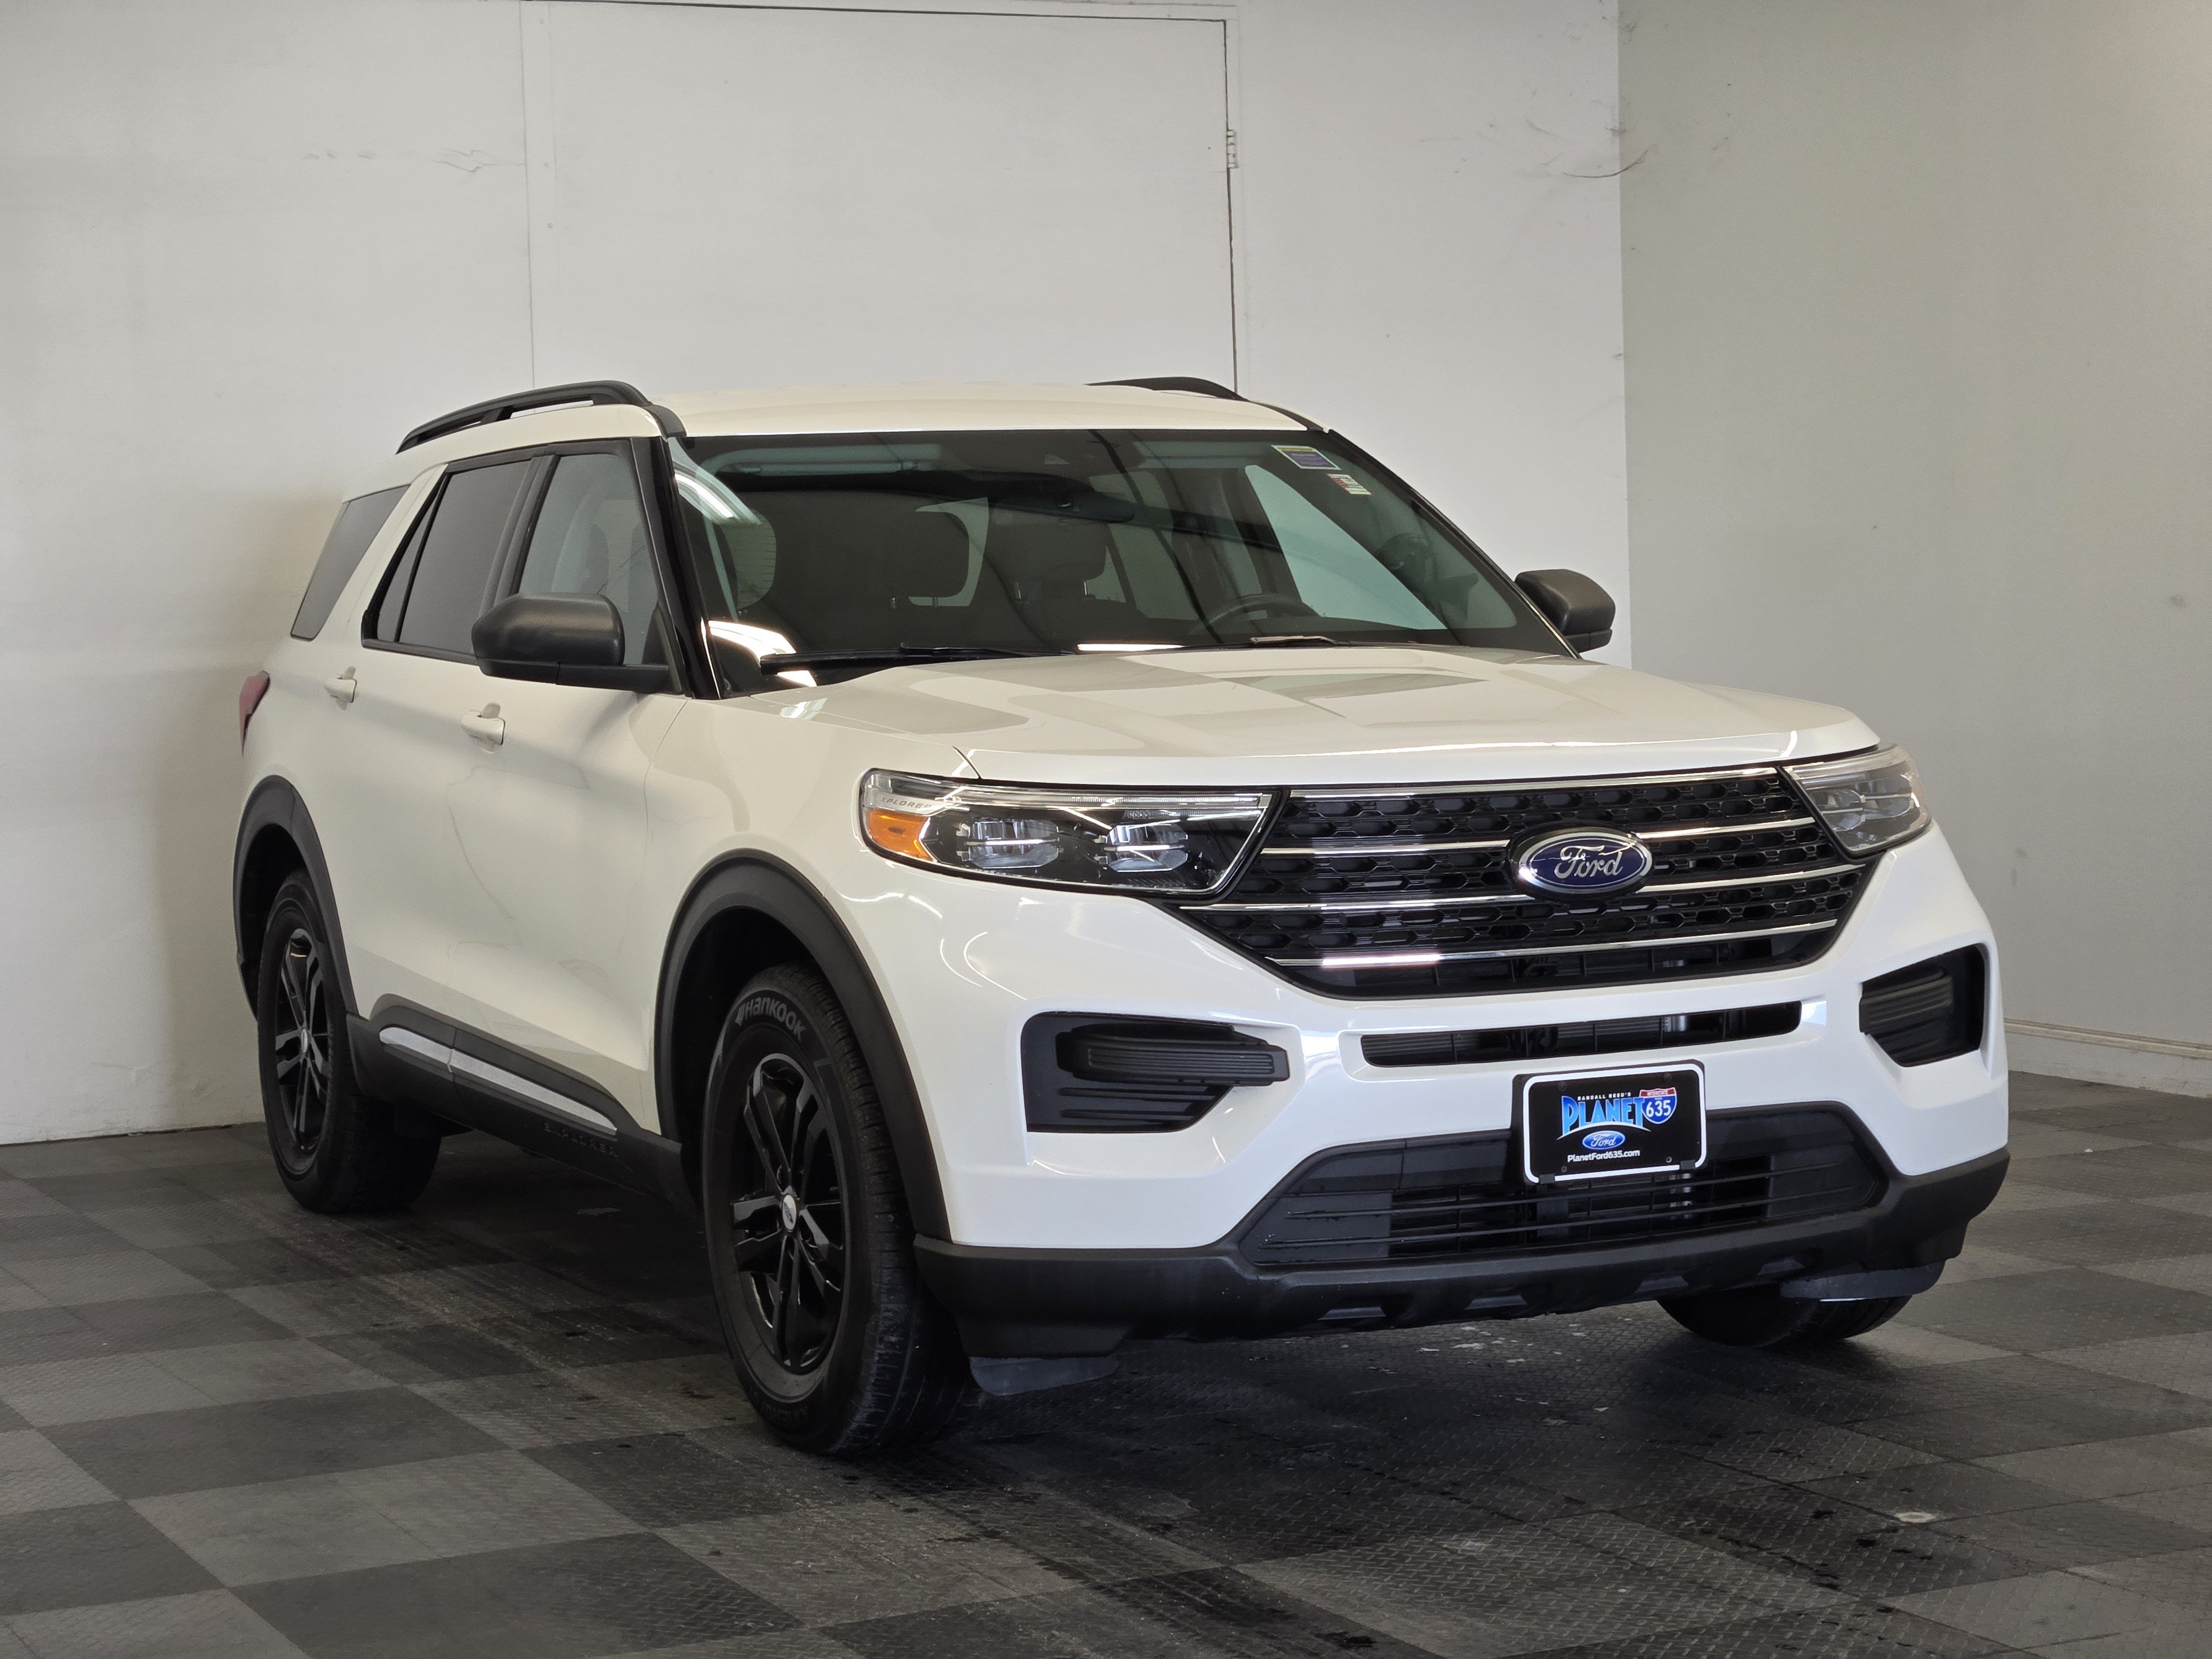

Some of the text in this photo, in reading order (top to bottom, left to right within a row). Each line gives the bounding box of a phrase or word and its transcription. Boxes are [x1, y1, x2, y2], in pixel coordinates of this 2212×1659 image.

[1554, 845, 1623, 879] Ford
[1561, 1095, 1645, 1135] PLANET
[1646, 1099, 1672, 1118] 635
[1590, 1132, 1617, 1147] Ford
[1567, 1150, 1640, 1162] PlanetFord635.com
